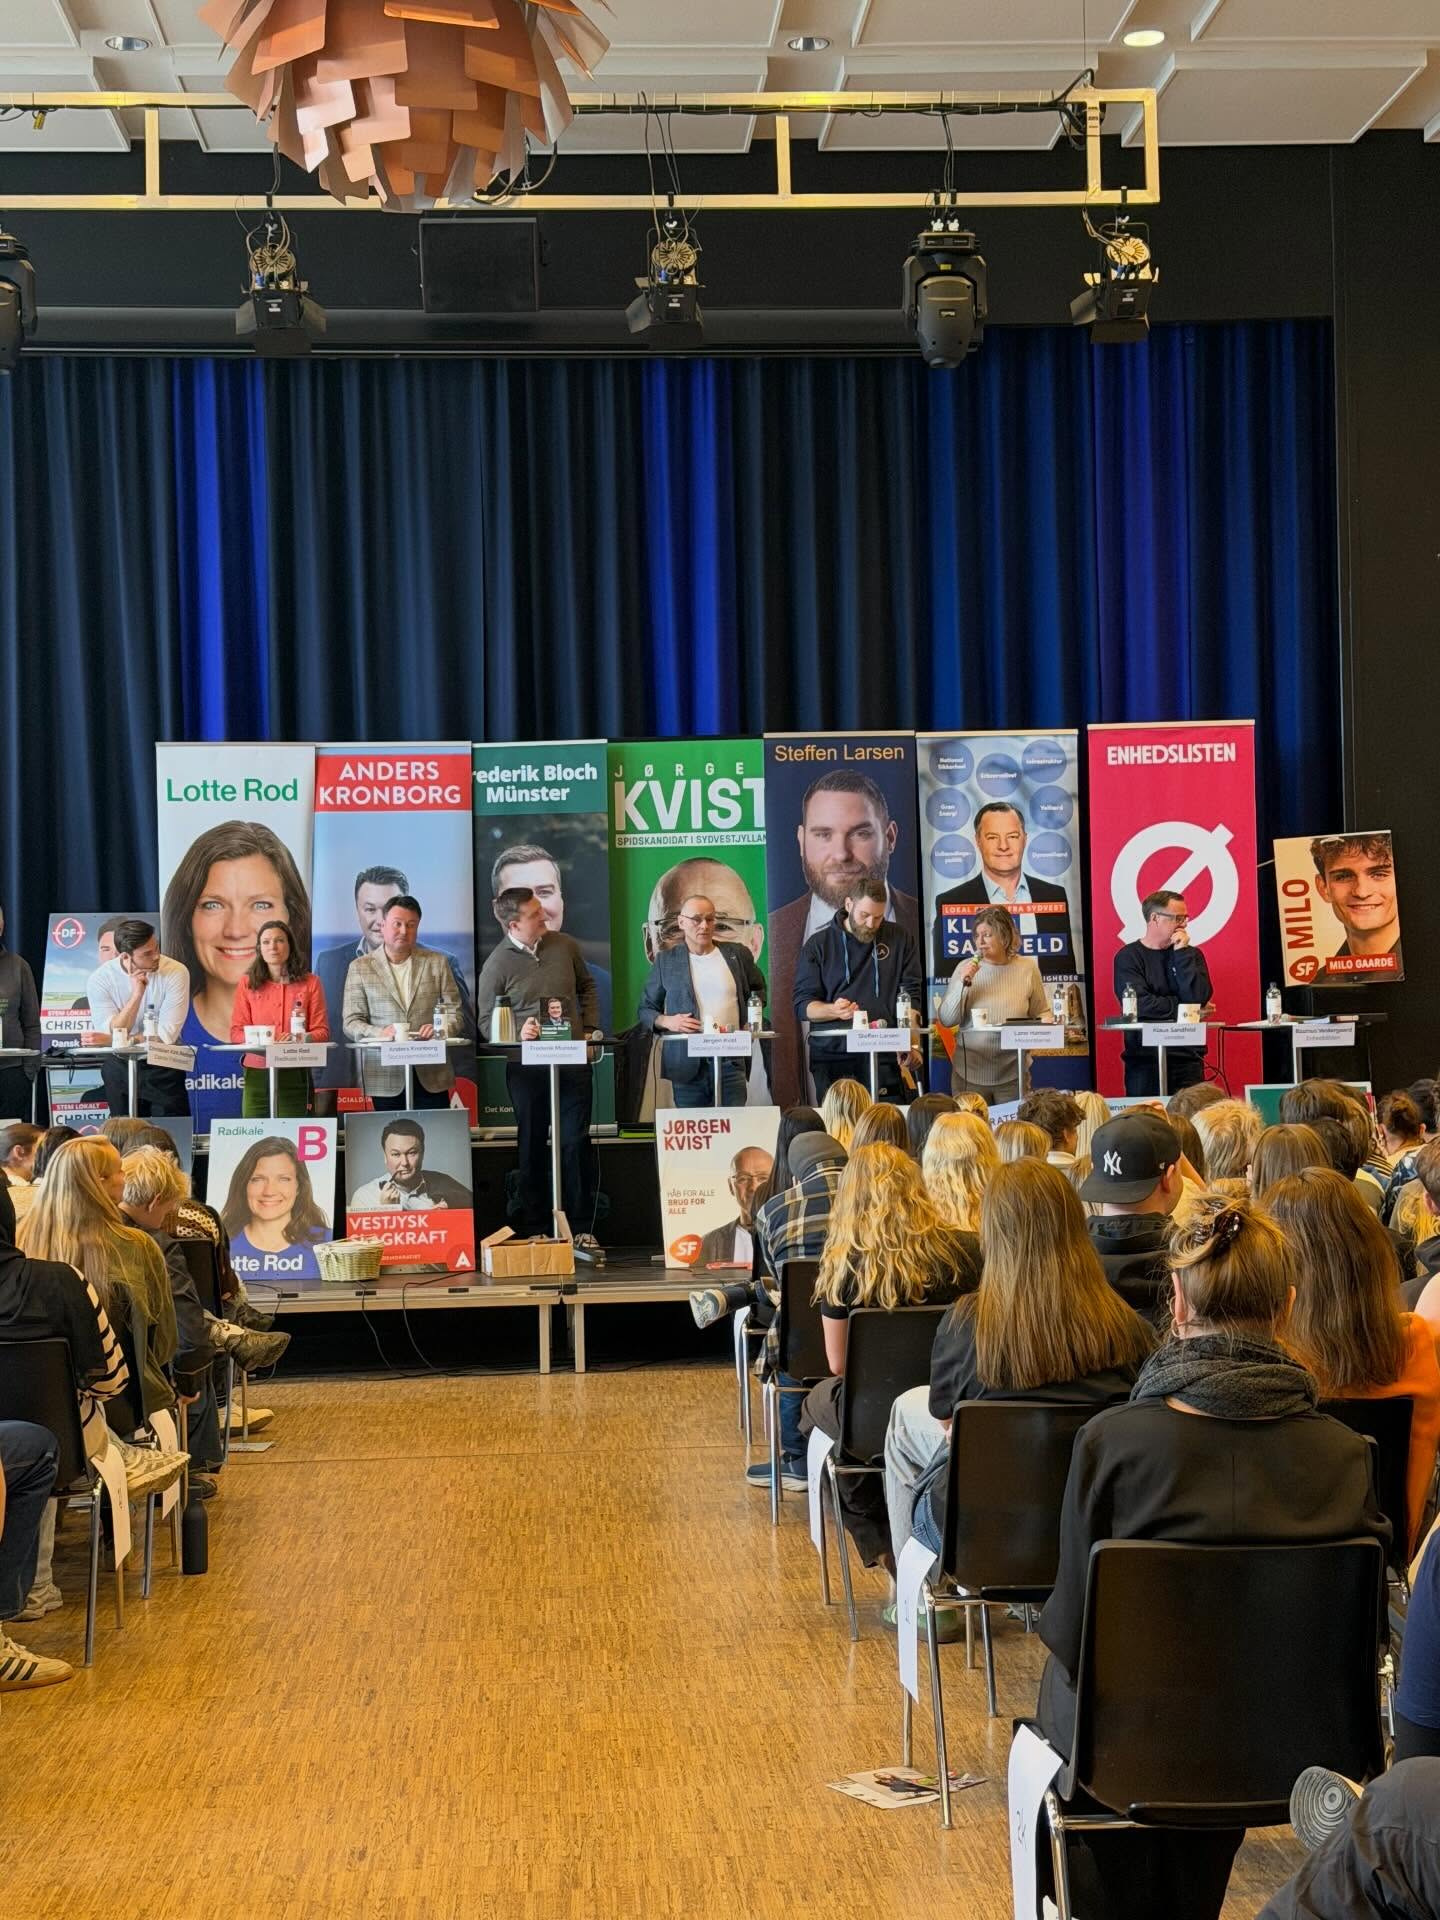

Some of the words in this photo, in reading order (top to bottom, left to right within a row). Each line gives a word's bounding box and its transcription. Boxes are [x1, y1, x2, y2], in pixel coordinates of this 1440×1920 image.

[775, 744, 837, 762] Steffen
[843, 743, 904, 760] Larsen
[1107, 743, 1236, 765] ENHEDSLISTEN
[338, 761, 440, 781] ANDERS
[472, 764, 540, 783] ederik
[544, 763, 598, 781] Bloch
[614, 761, 745, 778] JØRGE
[167, 778, 237, 802] Lotte
[244, 778, 298, 802] Rod
[319, 785, 461, 805] KRONBORG
[486, 785, 570, 803] Münster
[614, 777, 766, 831] KVIST
[617, 835, 688, 847] SPIDSKANDIDAT
[696, 833, 767, 844] SYDVESTJYLLAN
[1282, 878, 1315, 950] MILO
[61, 928, 76, 938] DF
[947, 937, 1064, 955] SAELD
[1295, 961, 1315, 977] SF
[1329, 960, 1353, 970] MILO
[1355, 957, 1393, 969] GAARDE
[1043, 974, 1079, 982] IGHEDER
[52, 1039, 81, 1048] Dansk
[184, 1073, 246, 1090] adikale
[217, 1126, 264, 1136] Radikale
[663, 1119, 731, 1135] JØRGEN
[297, 1125, 328, 1161] B
[664, 1135, 713, 1150] KVIST
[683, 1189, 697, 1197] FOR
[698, 1188, 716, 1197] ALLE
[668, 1207, 687, 1215] ALLE
[349, 1214, 429, 1230] VESTJYSK
[350, 1230, 448, 1246] GKRAFT
[675, 1241, 698, 1257] SF
[230, 1255, 261, 1272] tte
[263, 1254, 304, 1272] Rod
[455, 1250, 472, 1268] A
